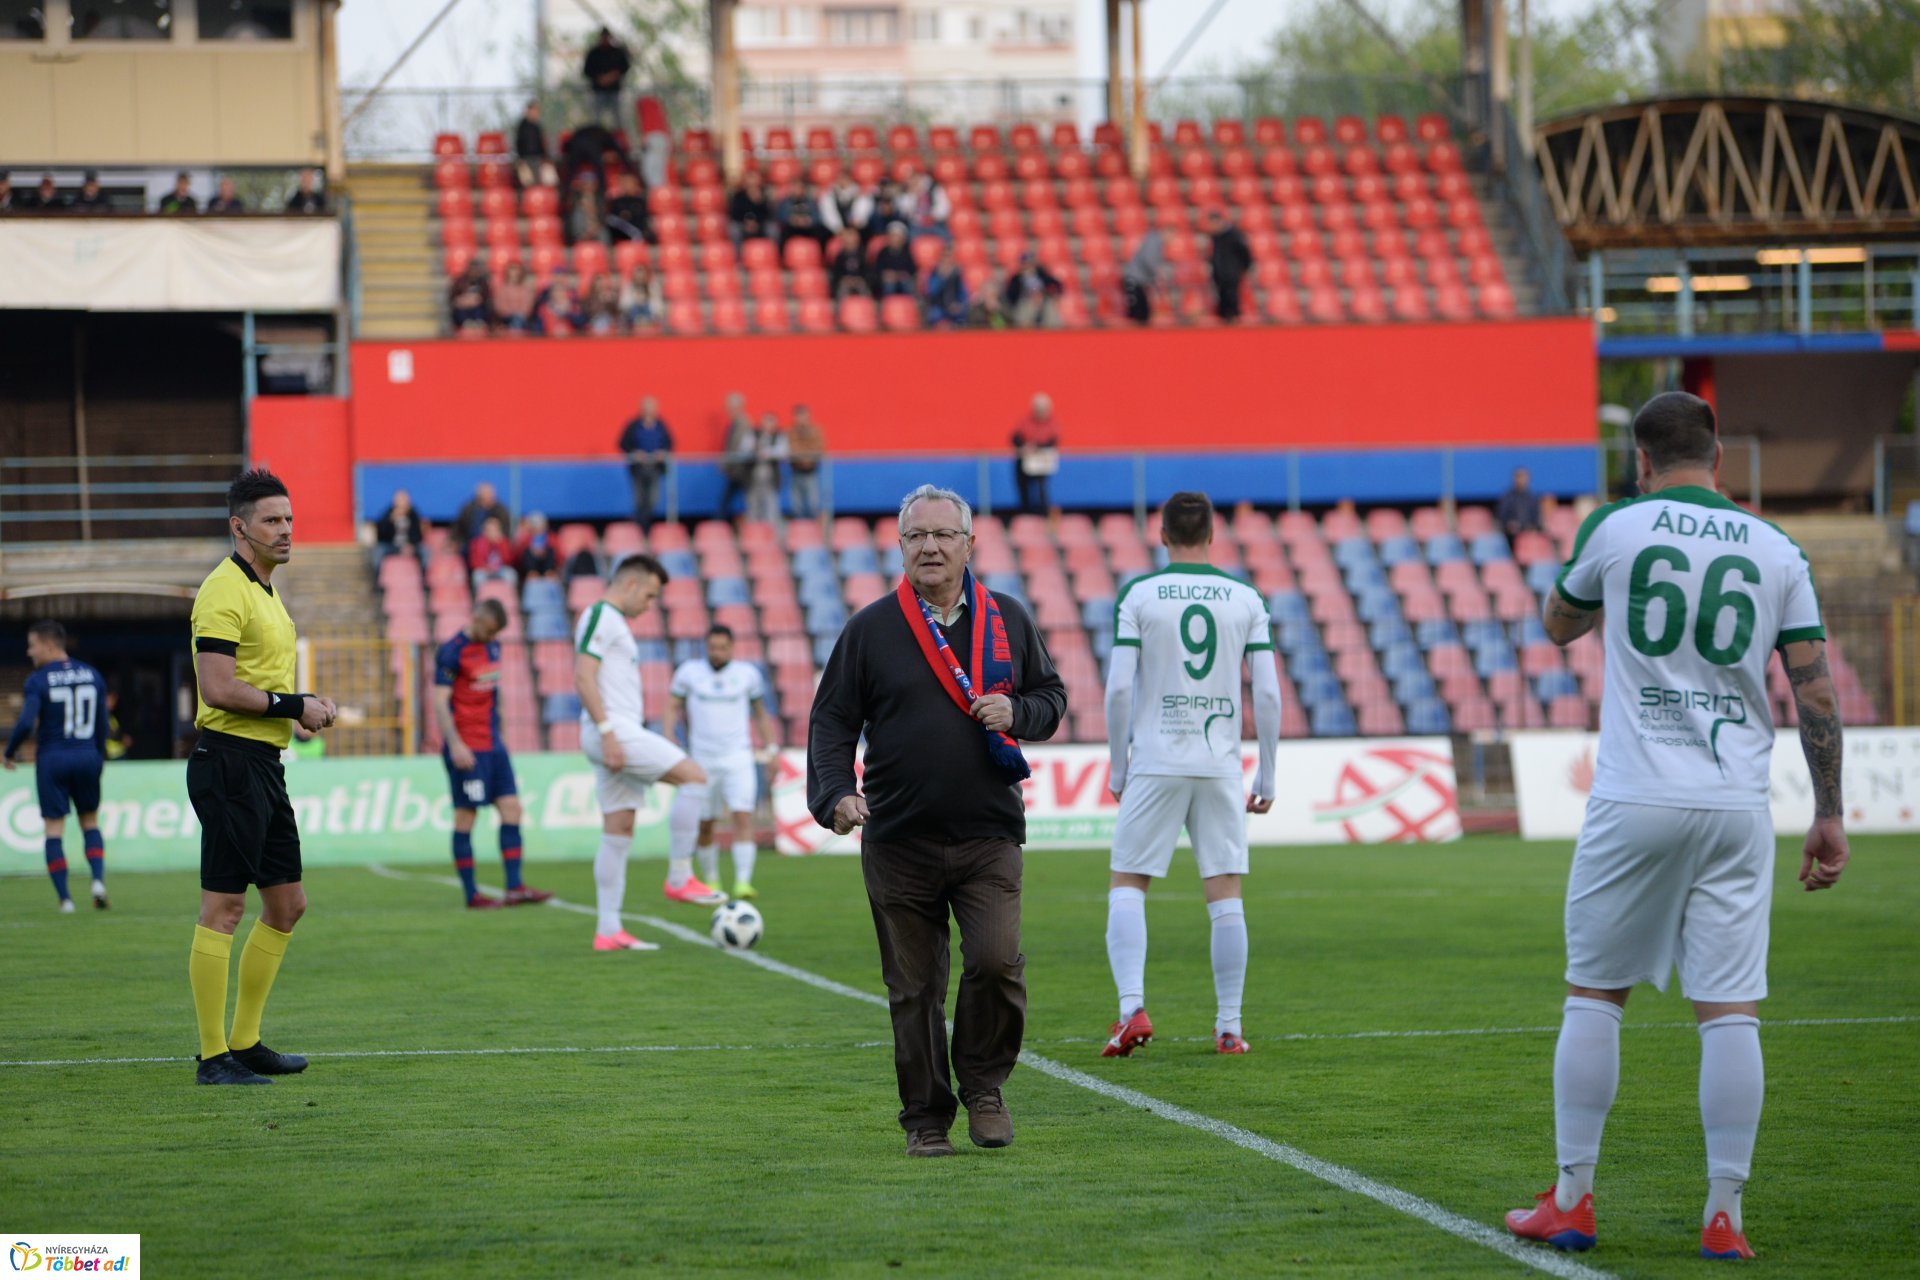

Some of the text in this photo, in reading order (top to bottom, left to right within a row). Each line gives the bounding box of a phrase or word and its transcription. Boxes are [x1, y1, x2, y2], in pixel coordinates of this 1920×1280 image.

[1652, 506, 1749, 544] ÁDÁM
[1157, 584, 1232, 601] BELICZKY
[1628, 544, 1761, 666] 66
[1180, 603, 1217, 681] 9
[49, 684, 97, 739] 70
[1161, 710, 1188, 719] AUTO
[1162, 695, 1232, 711] SPIRIT
[1640, 687, 1742, 715] SPIRIT
[1640, 708, 1683, 721] AUTO
